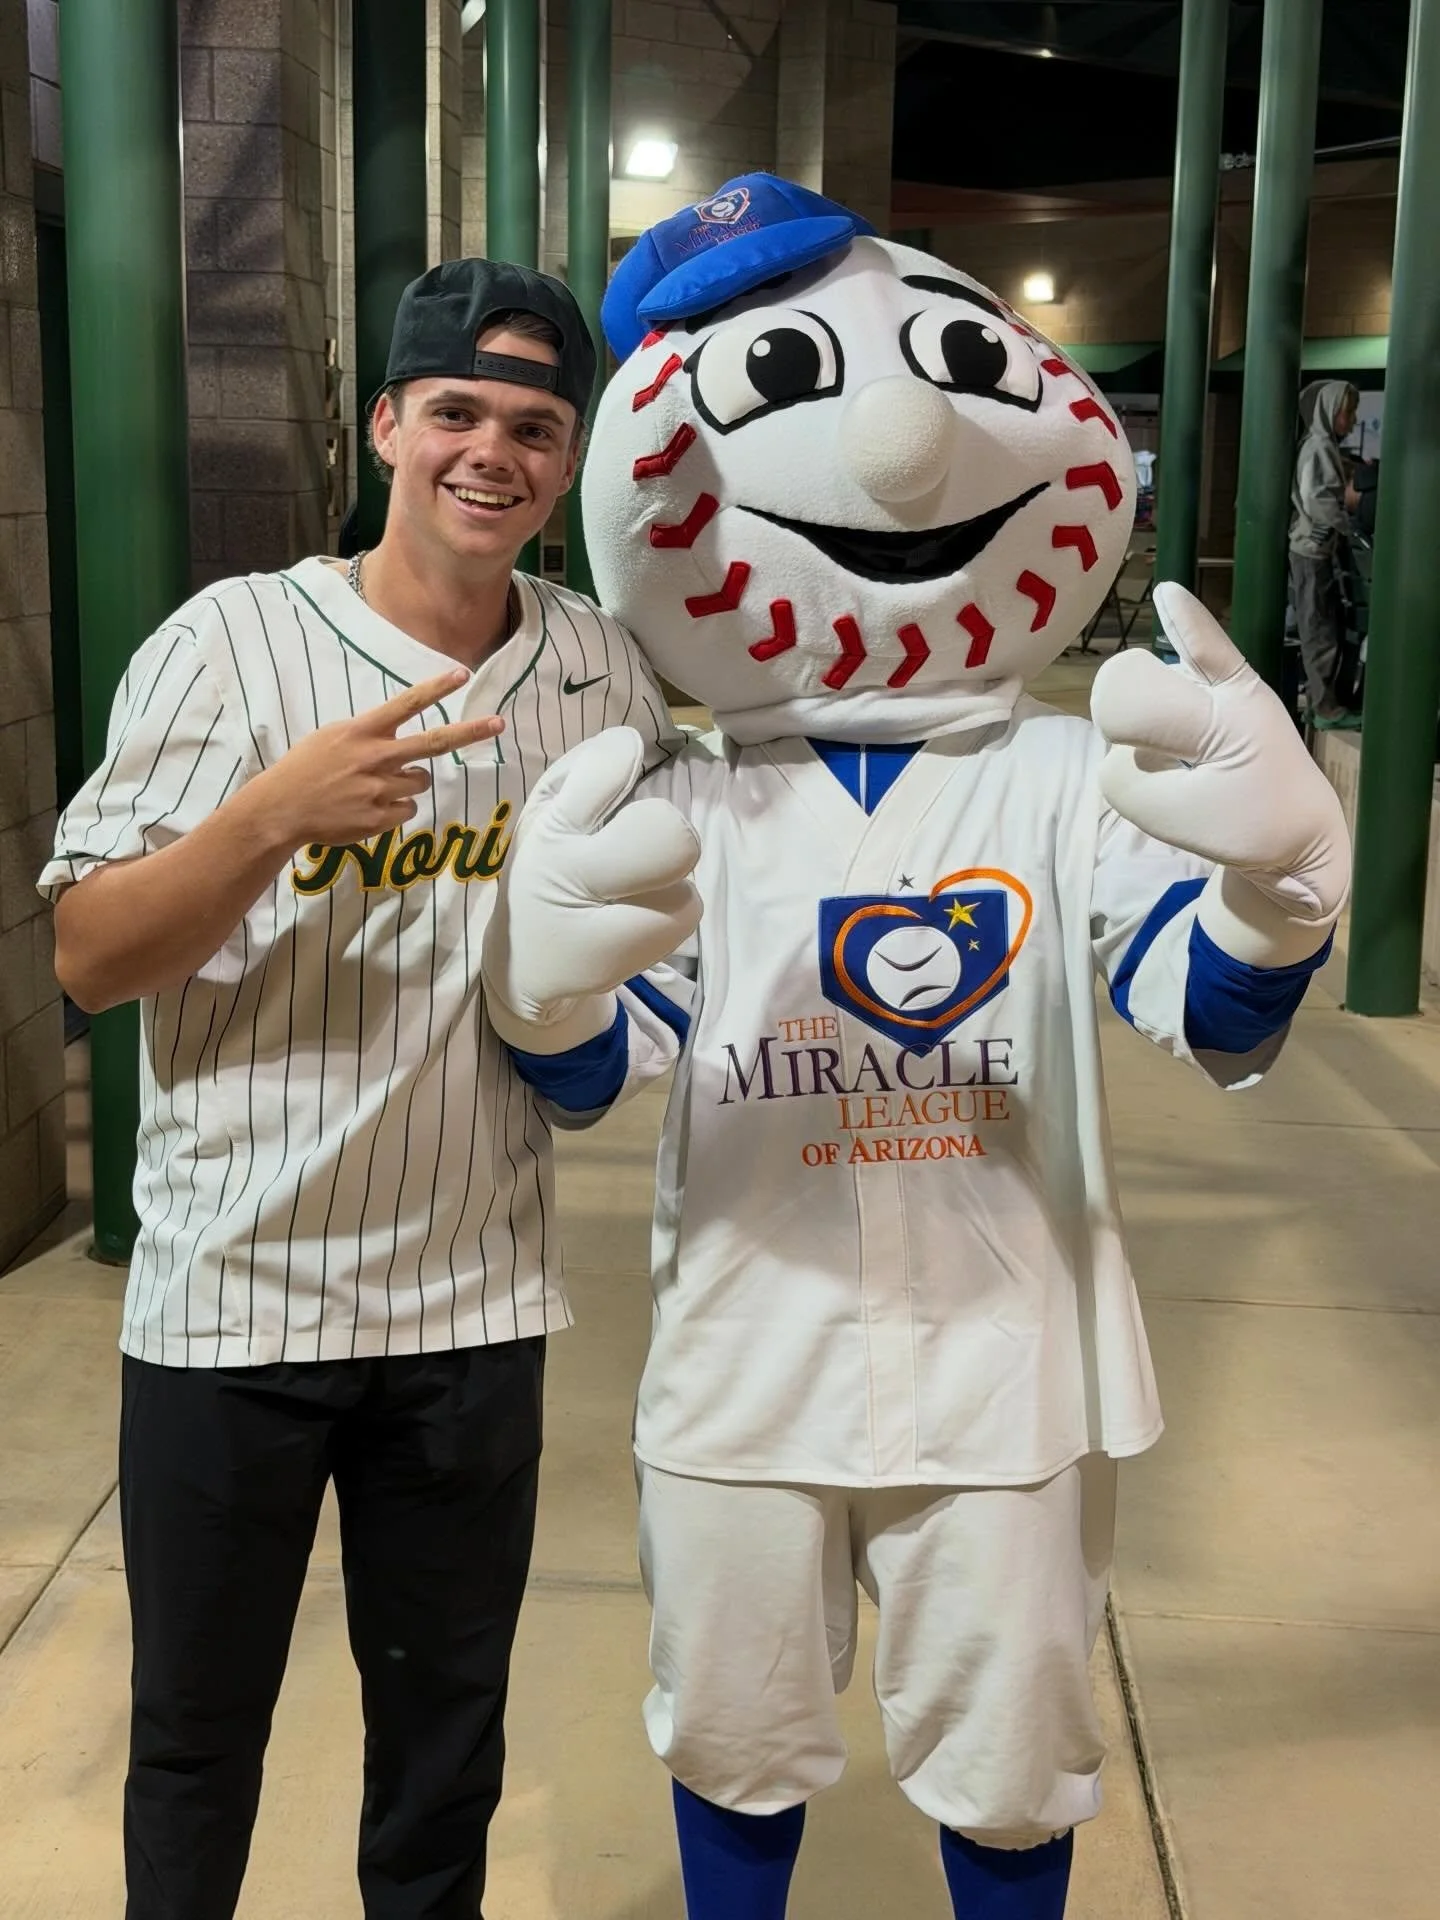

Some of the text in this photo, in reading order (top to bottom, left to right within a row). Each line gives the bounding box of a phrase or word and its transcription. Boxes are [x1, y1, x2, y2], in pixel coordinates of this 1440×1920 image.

[778, 1016, 840, 1043] THE
[717, 1037, 1018, 1105] MIRACLE
[837, 1090, 1010, 1130] LEAGUE
[802, 1134, 988, 1167] OF ARIZONA
